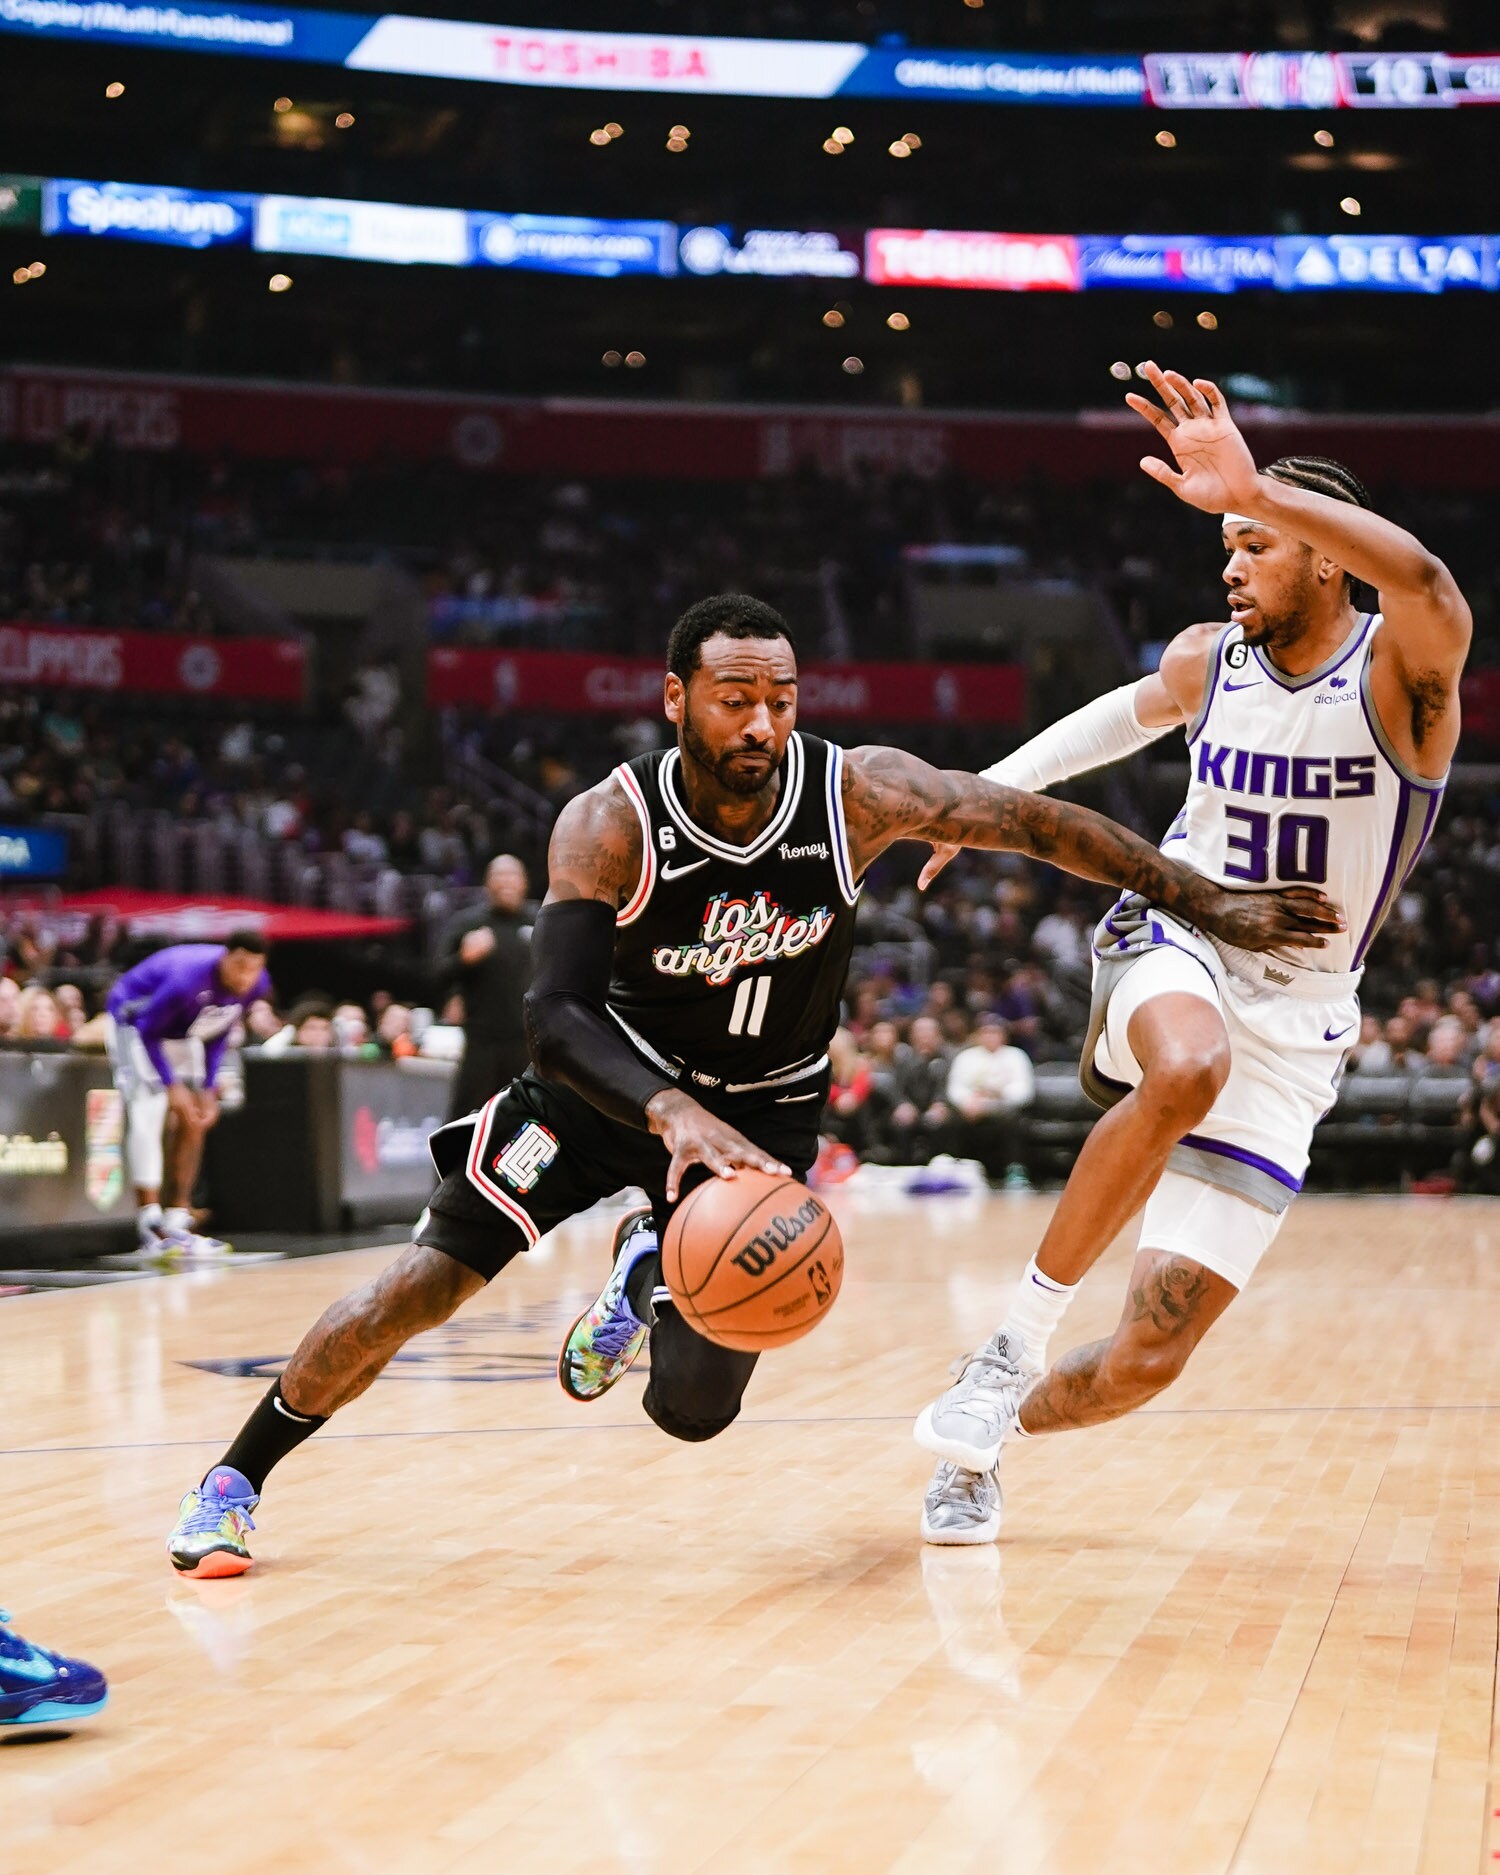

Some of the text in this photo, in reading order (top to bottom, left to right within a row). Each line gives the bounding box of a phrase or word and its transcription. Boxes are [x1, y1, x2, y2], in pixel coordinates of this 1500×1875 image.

[493, 36, 708, 78] TOSHIBA
[67, 186, 236, 235] Spectrum
[877, 238, 1075, 282] TOSHIBA
[1338, 246, 1479, 284] DELTA
[1230, 643, 1248, 667] 6
[1314, 690, 1357, 706] dialpad
[1197, 740, 1376, 800] KINGS
[658, 826, 677, 850] 6
[778, 842, 829, 860] honey
[1224, 804, 1330, 884] 30
[702, 895, 780, 943] los
[653, 910, 833, 984] angeles
[728, 976, 772, 1036] 11
[731, 1197, 825, 1277] Wilson
